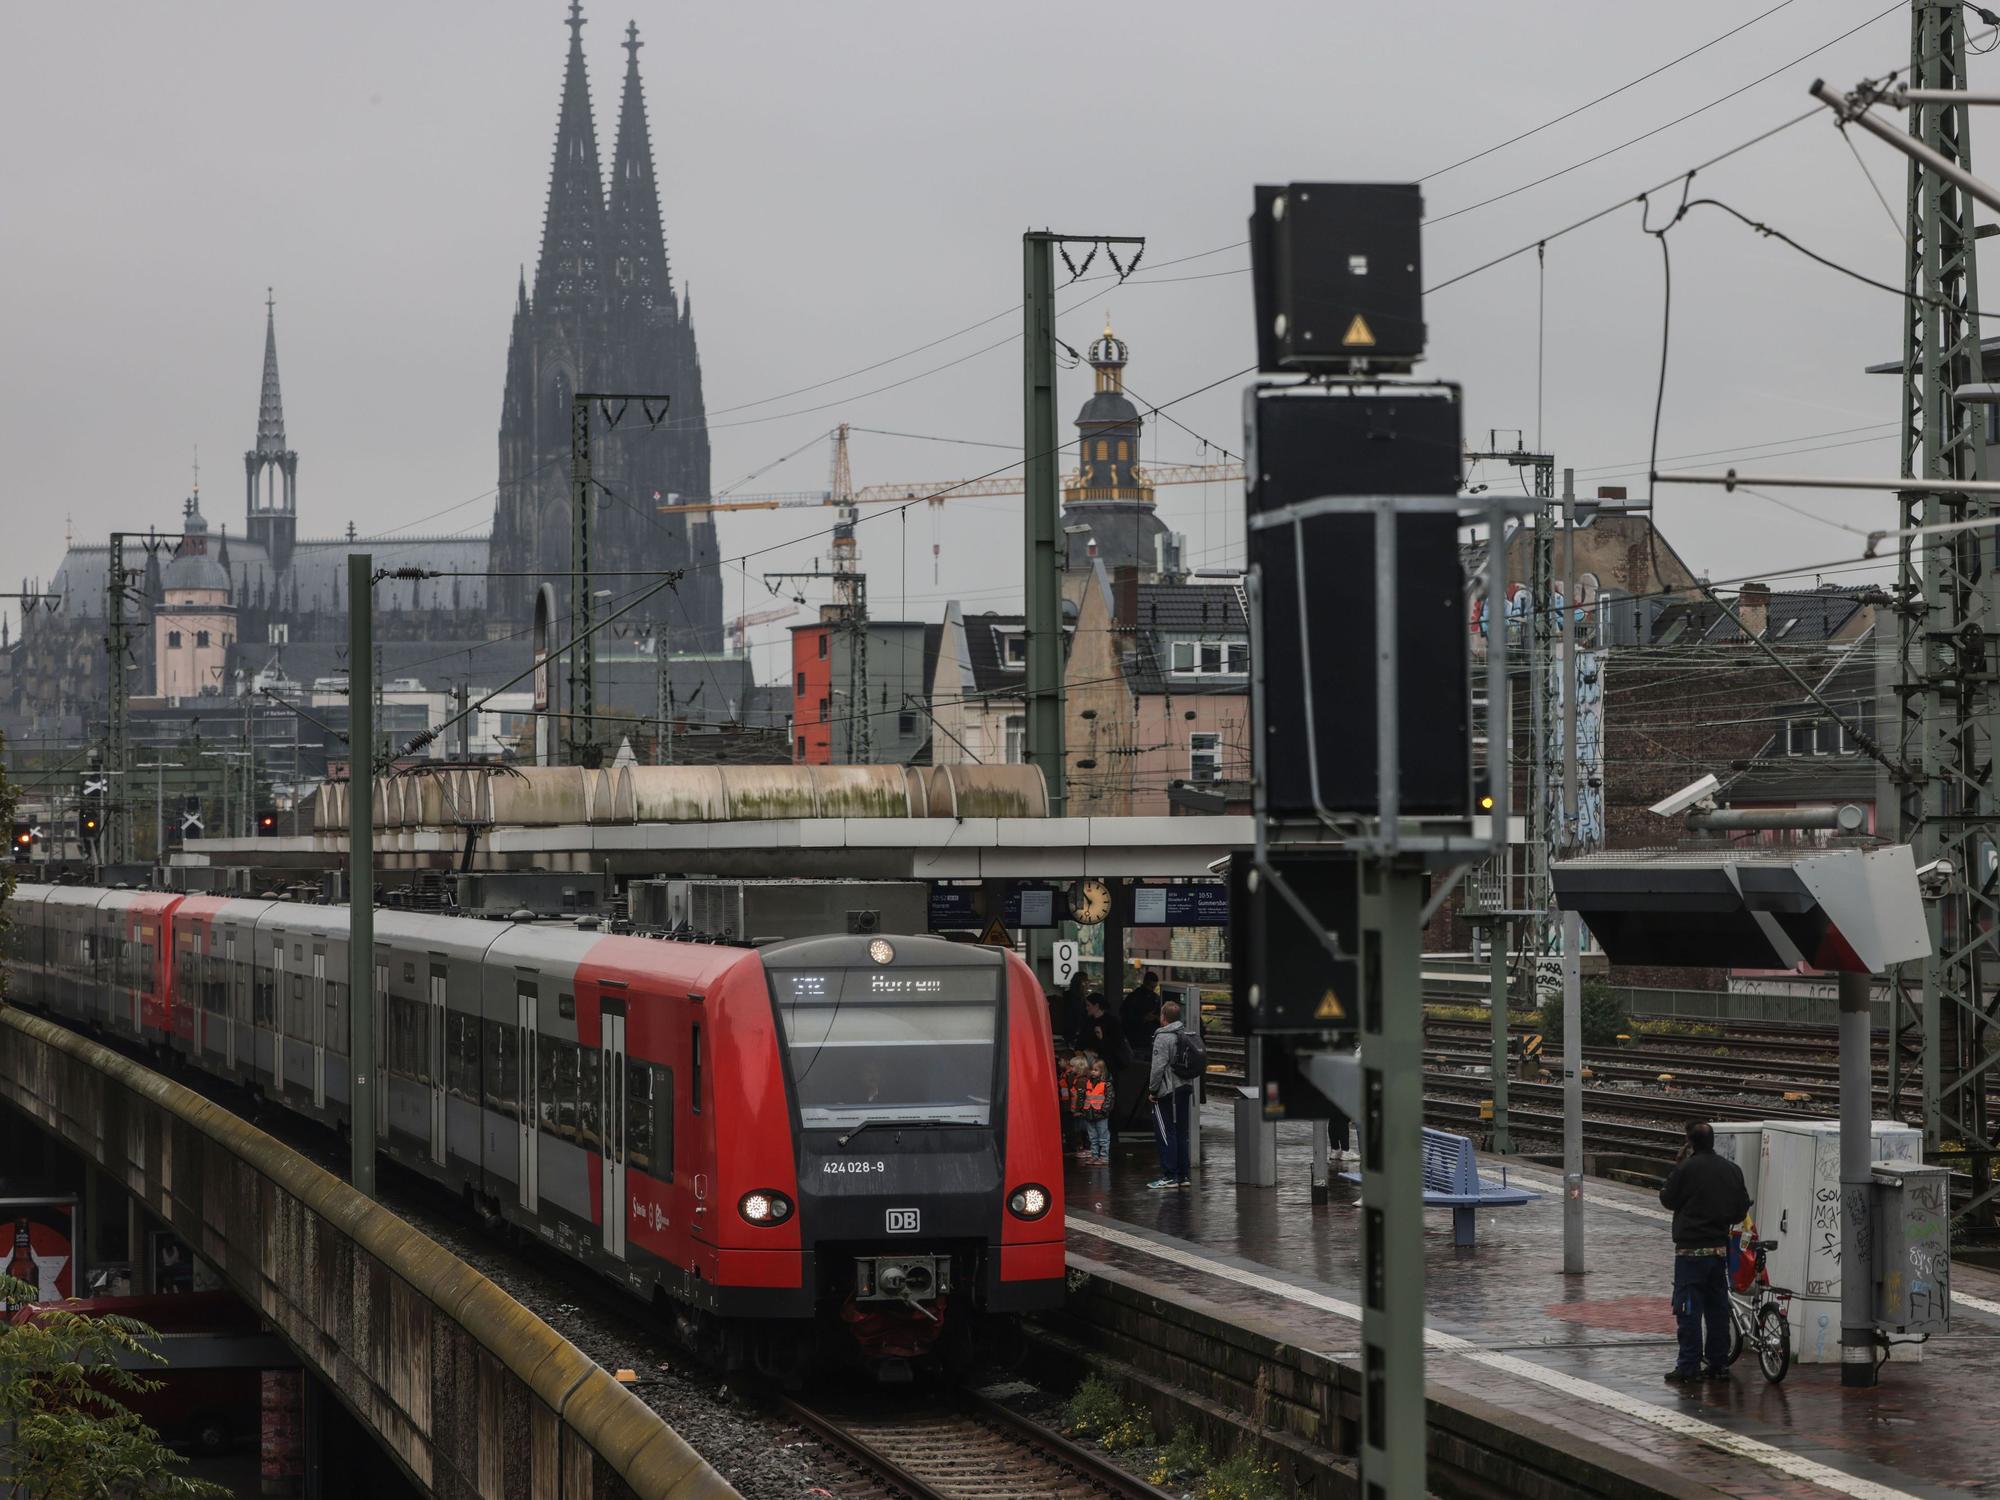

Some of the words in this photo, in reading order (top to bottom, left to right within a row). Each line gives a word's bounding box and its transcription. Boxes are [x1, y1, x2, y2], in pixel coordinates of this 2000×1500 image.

[1060, 944, 1072, 961] 0
[1060, 963, 1072, 980] 9
[824, 1162, 846, 1173] 424
[847, 1161, 884, 1173] 028-9
[888, 1211, 917, 1230] DB
